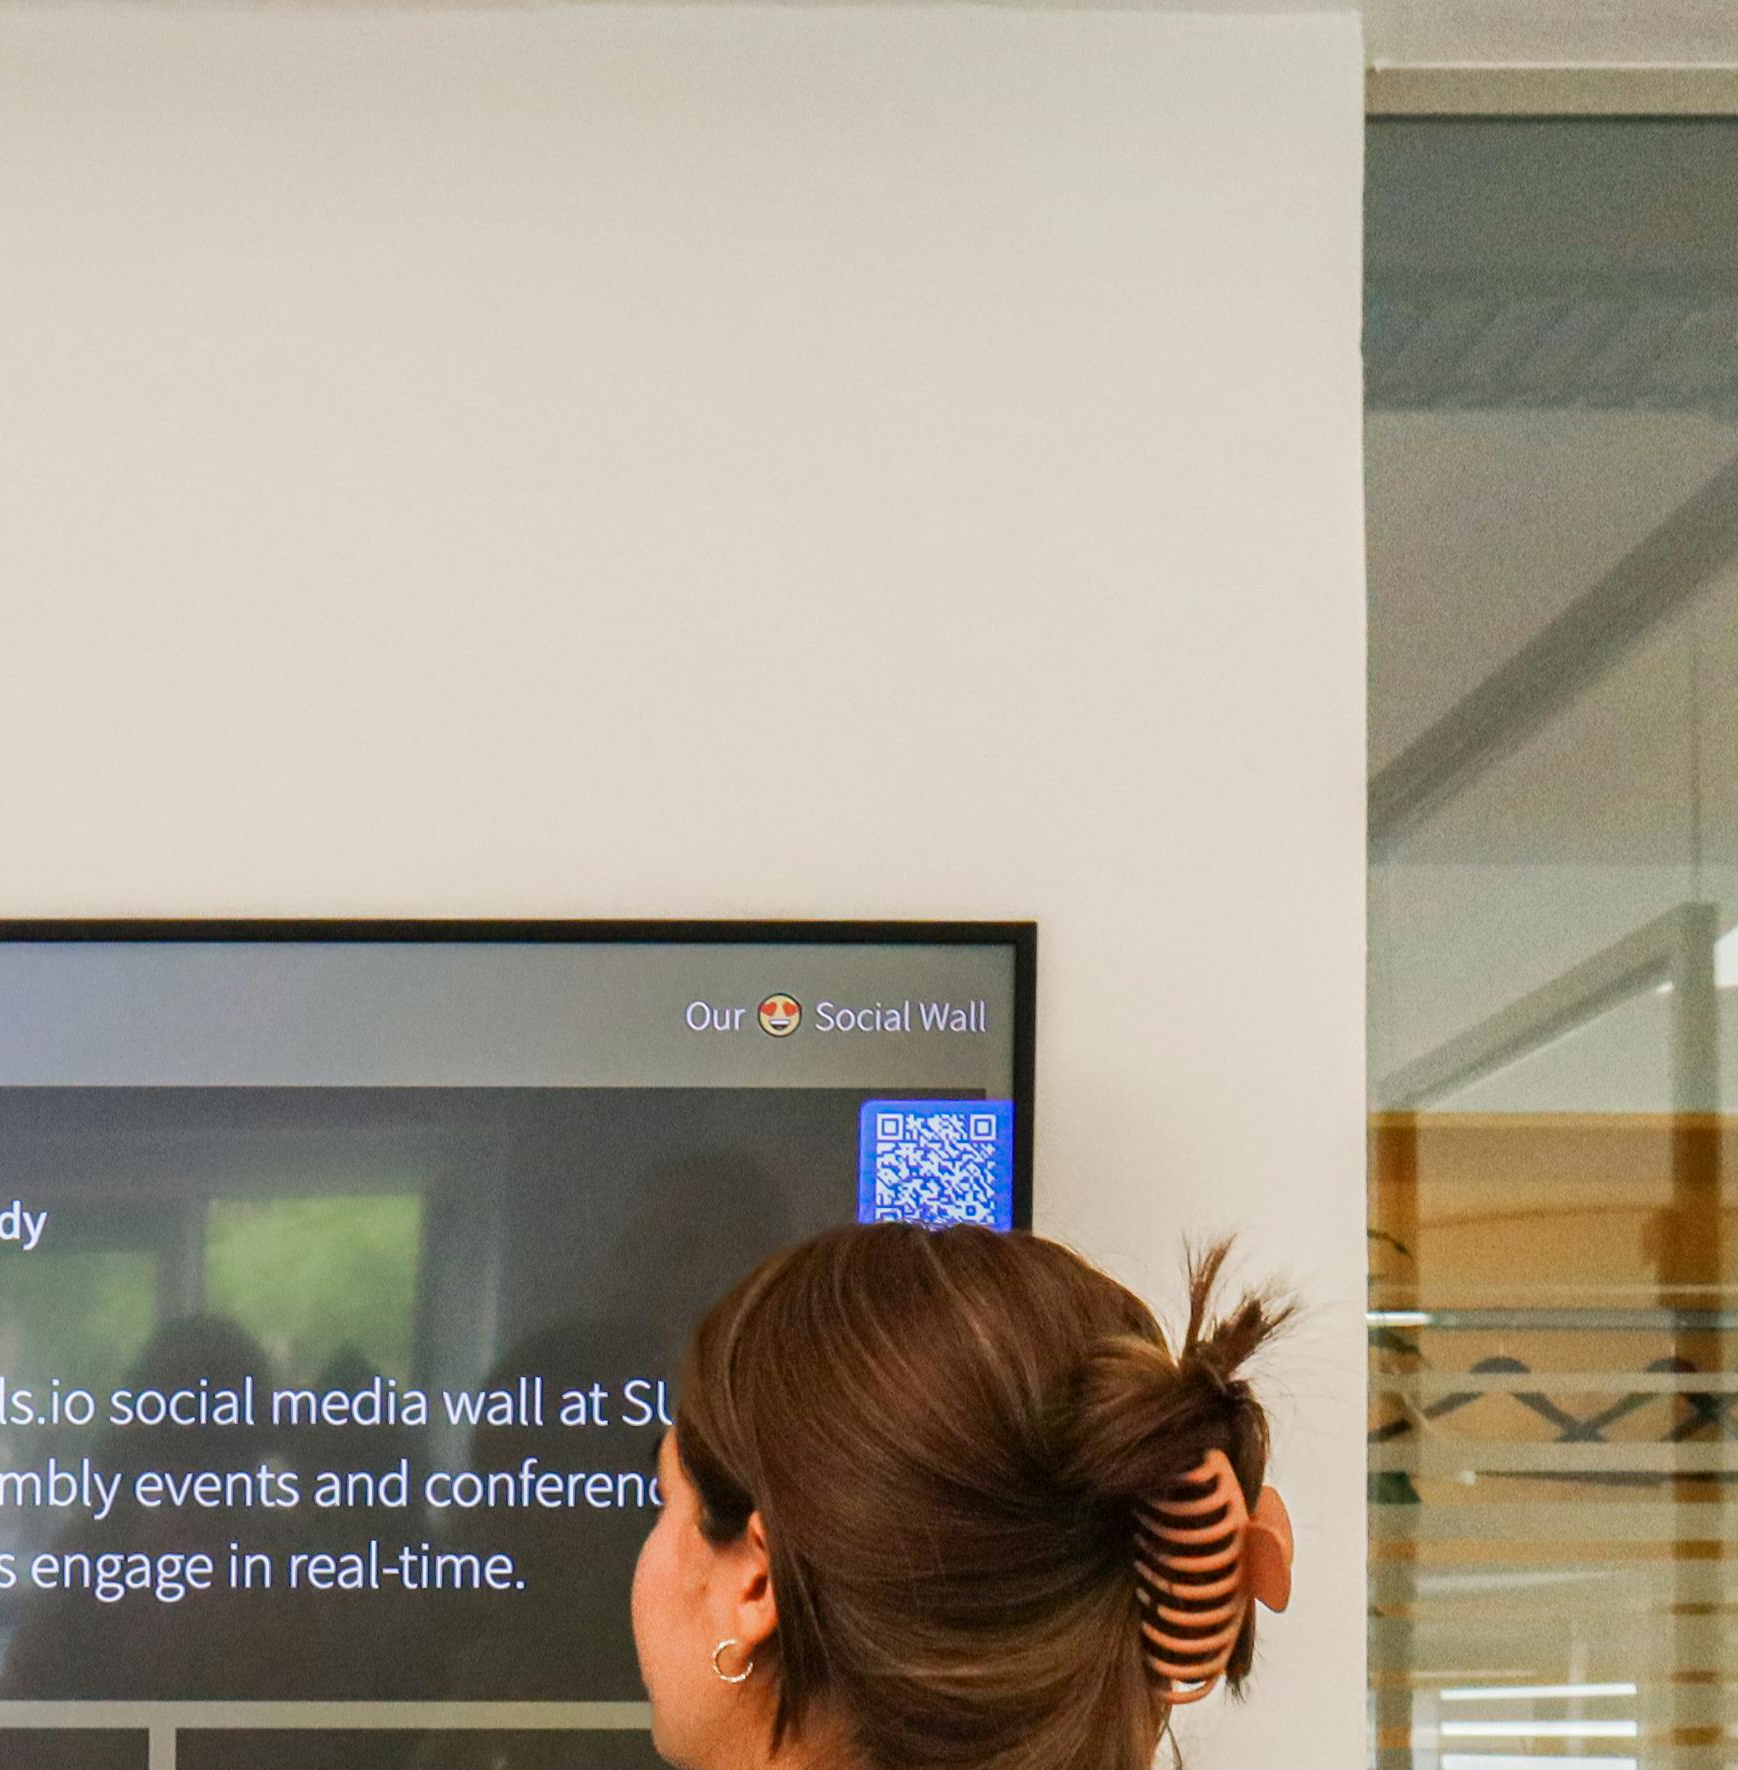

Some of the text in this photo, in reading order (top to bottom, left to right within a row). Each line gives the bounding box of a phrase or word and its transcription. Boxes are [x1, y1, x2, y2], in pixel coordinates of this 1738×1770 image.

[686, 1000, 987, 1033] Our Social Wall
[109, 1376, 256, 1427] social
[271, 1376, 429, 1427] media
[442, 1376, 545, 1427] wall
[560, 1382, 610, 1428] at
[134, 1464, 302, 1509] events
[314, 1458, 410, 1509] and
[31, 1553, 215, 1604] engage
[229, 1542, 273, 1590] in
[290, 1540, 527, 1591] real-time.
